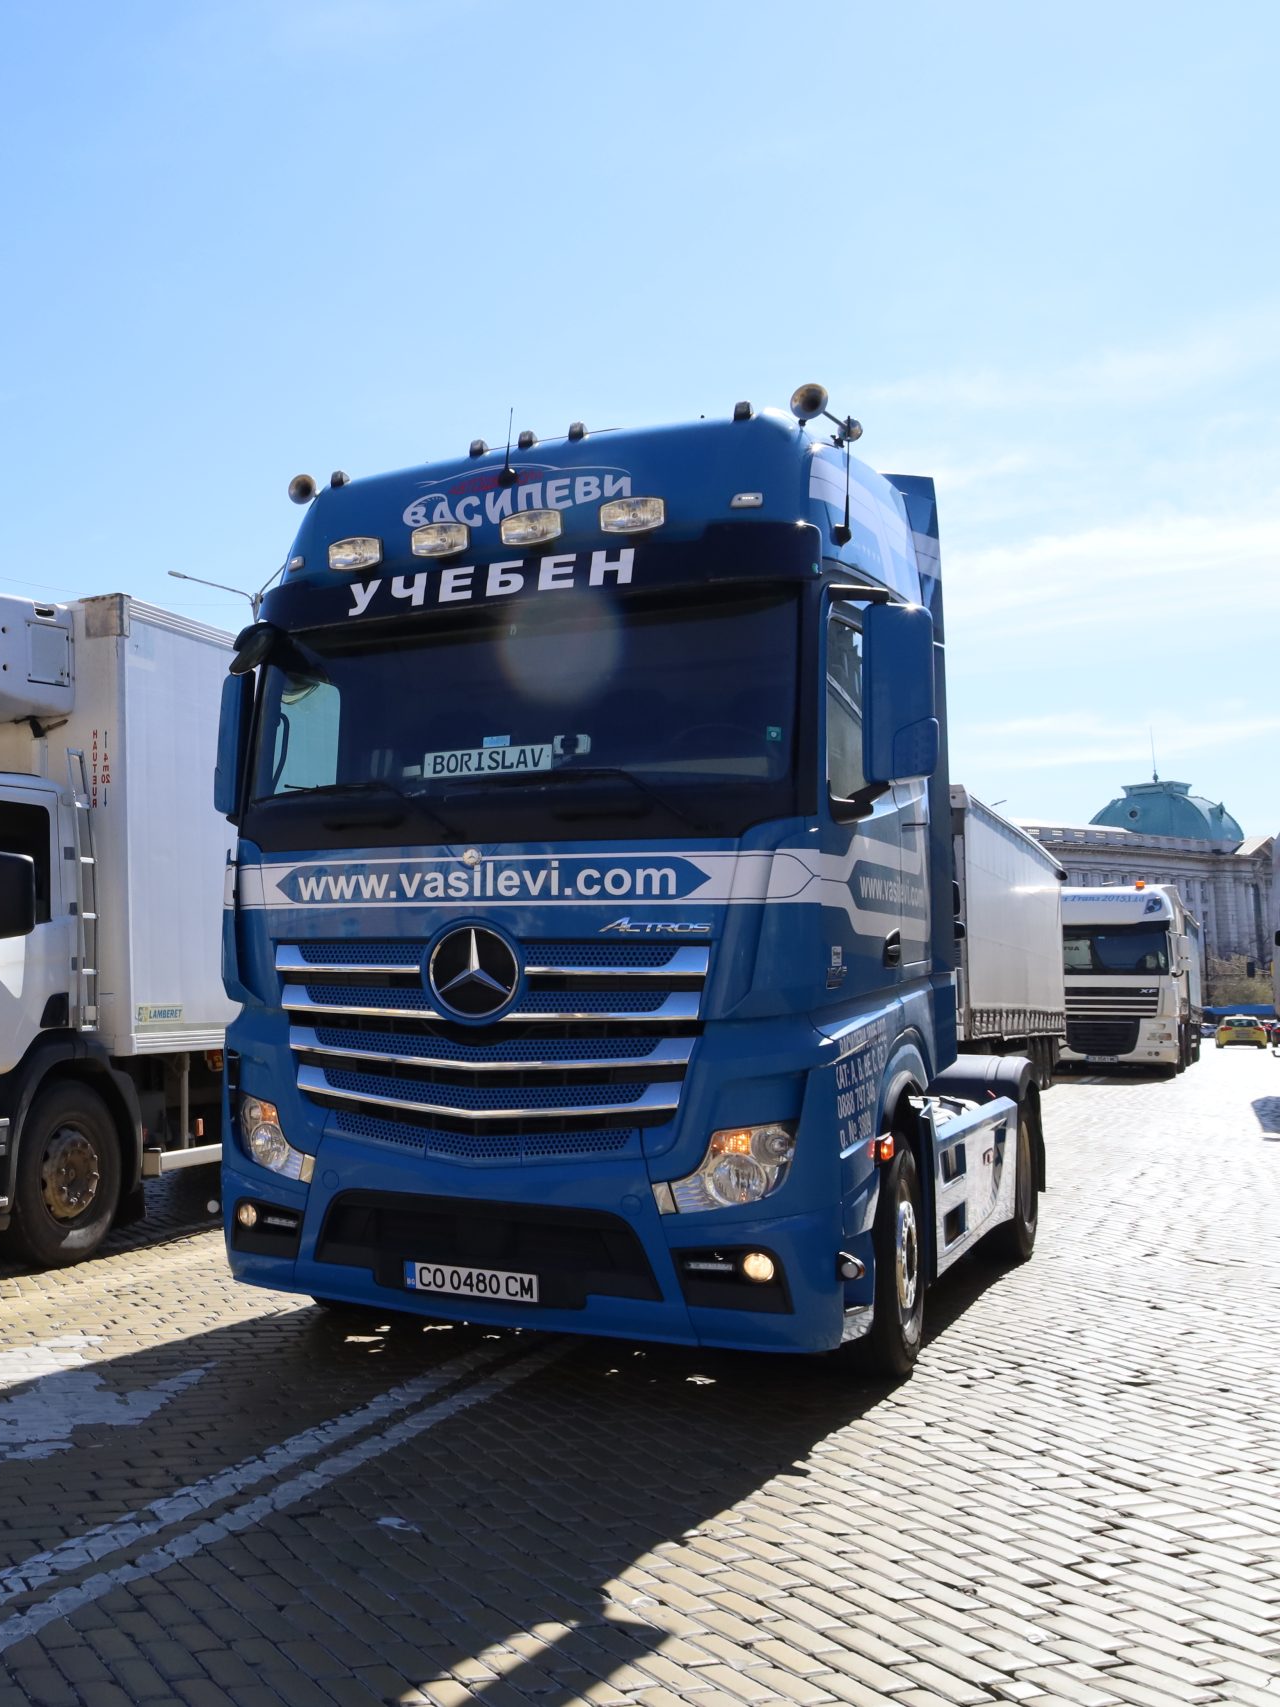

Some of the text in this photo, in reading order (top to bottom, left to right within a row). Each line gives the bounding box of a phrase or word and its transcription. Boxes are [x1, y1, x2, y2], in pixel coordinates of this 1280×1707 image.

[348, 548, 635, 617] УЧЕБЕН
[432, 747, 544, 774] BORISLAV
[298, 861, 677, 900] www.vasilevi.com
[148, 1008, 182, 1019] LAMBERET
[419, 1266, 534, 1299] CO 0480 CM
